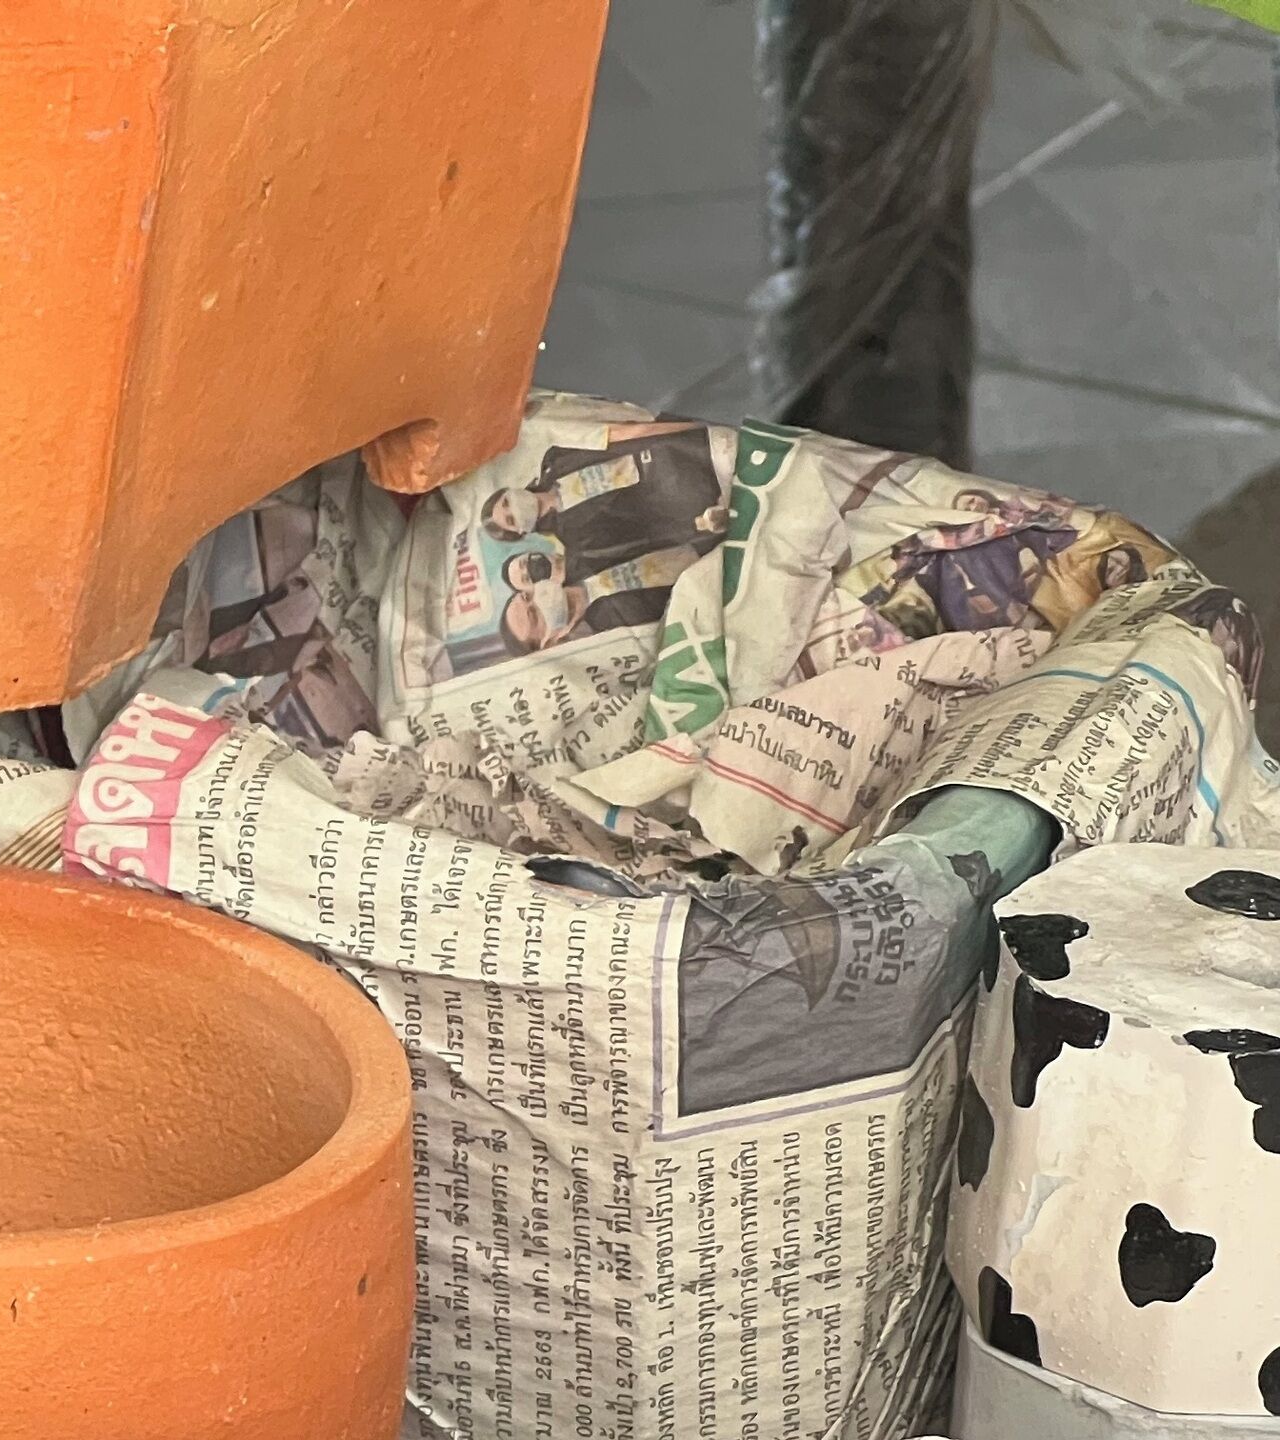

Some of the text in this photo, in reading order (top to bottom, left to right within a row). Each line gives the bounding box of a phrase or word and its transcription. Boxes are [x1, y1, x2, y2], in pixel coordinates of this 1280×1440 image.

[612, 1297, 633, 1328] ราย
[534, 1329, 555, 1381] 2563
[614, 1335, 639, 1389] 2,700
[646, 1344, 675, 1374] คือ
